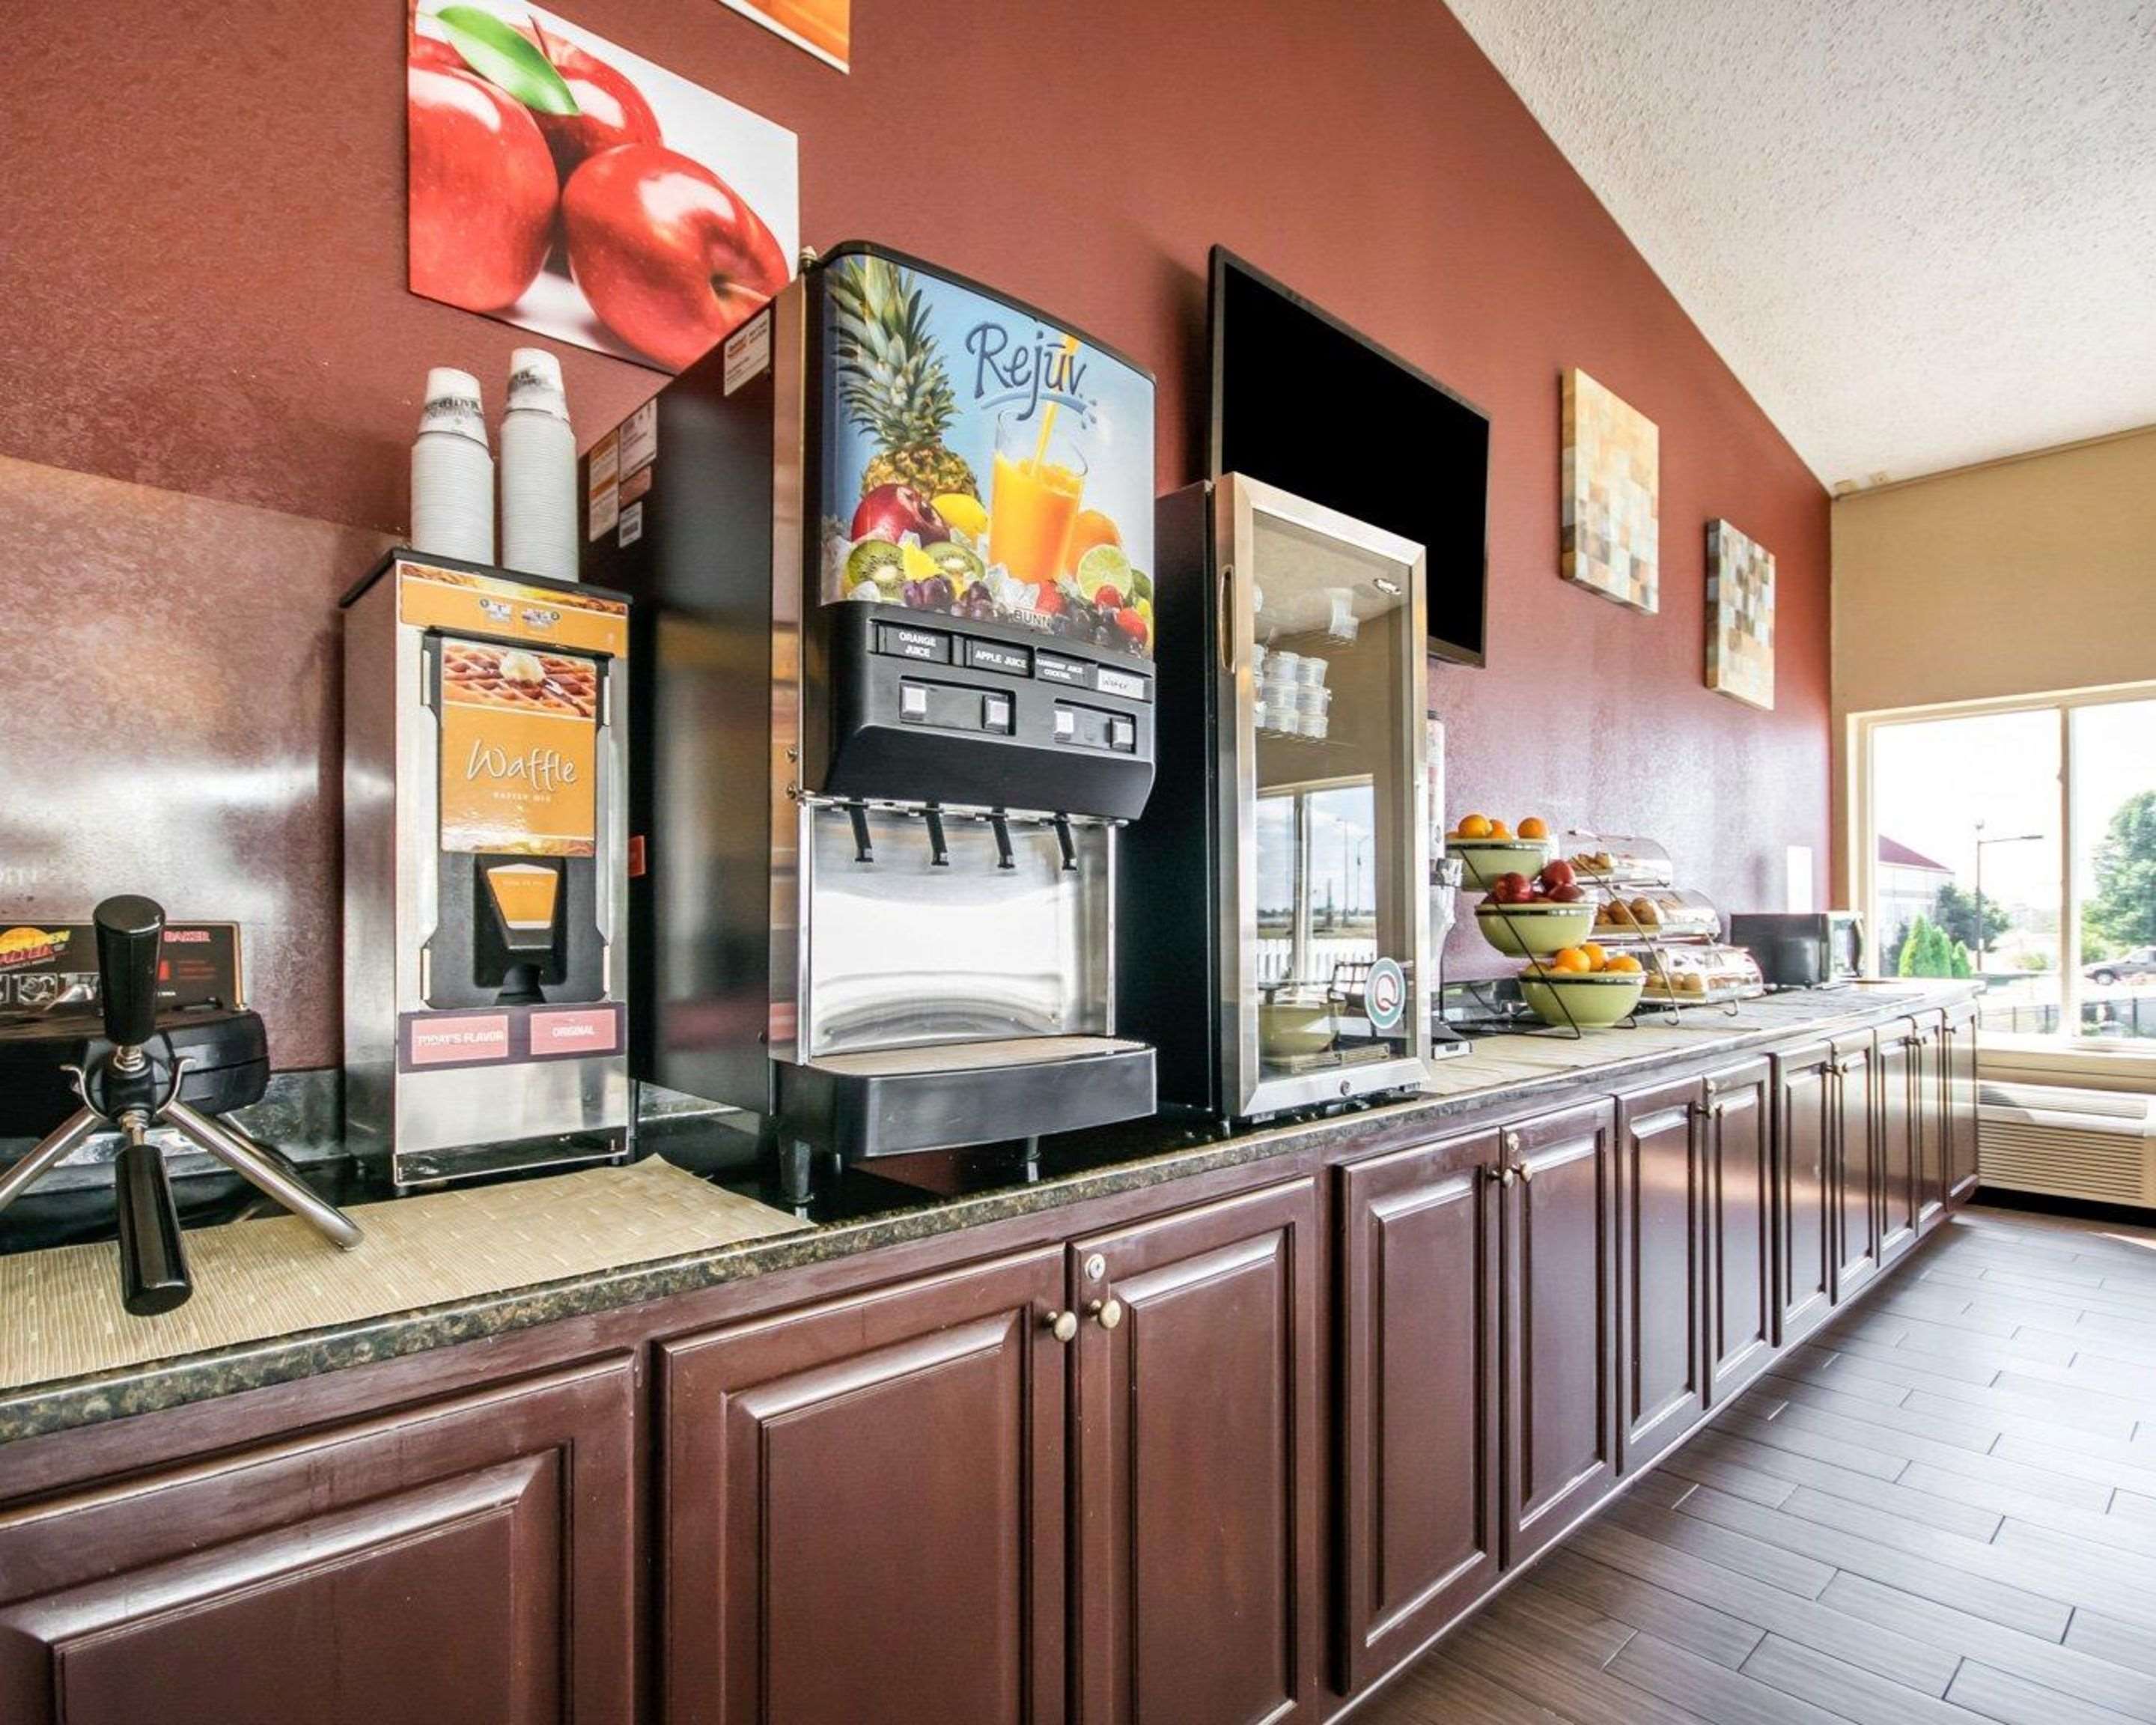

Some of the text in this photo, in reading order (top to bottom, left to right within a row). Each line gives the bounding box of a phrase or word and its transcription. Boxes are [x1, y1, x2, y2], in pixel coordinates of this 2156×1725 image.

[898, 631, 937, 648] ORANGE
[904, 644, 931, 658] JUICE
[975, 650, 1027, 669] APPLE JUICE
[466, 738, 576, 792] Waffle
[418, 1029, 504, 1046] TODAY'S FLAVOR
[552, 1023, 595, 1038] ORIGINAL
